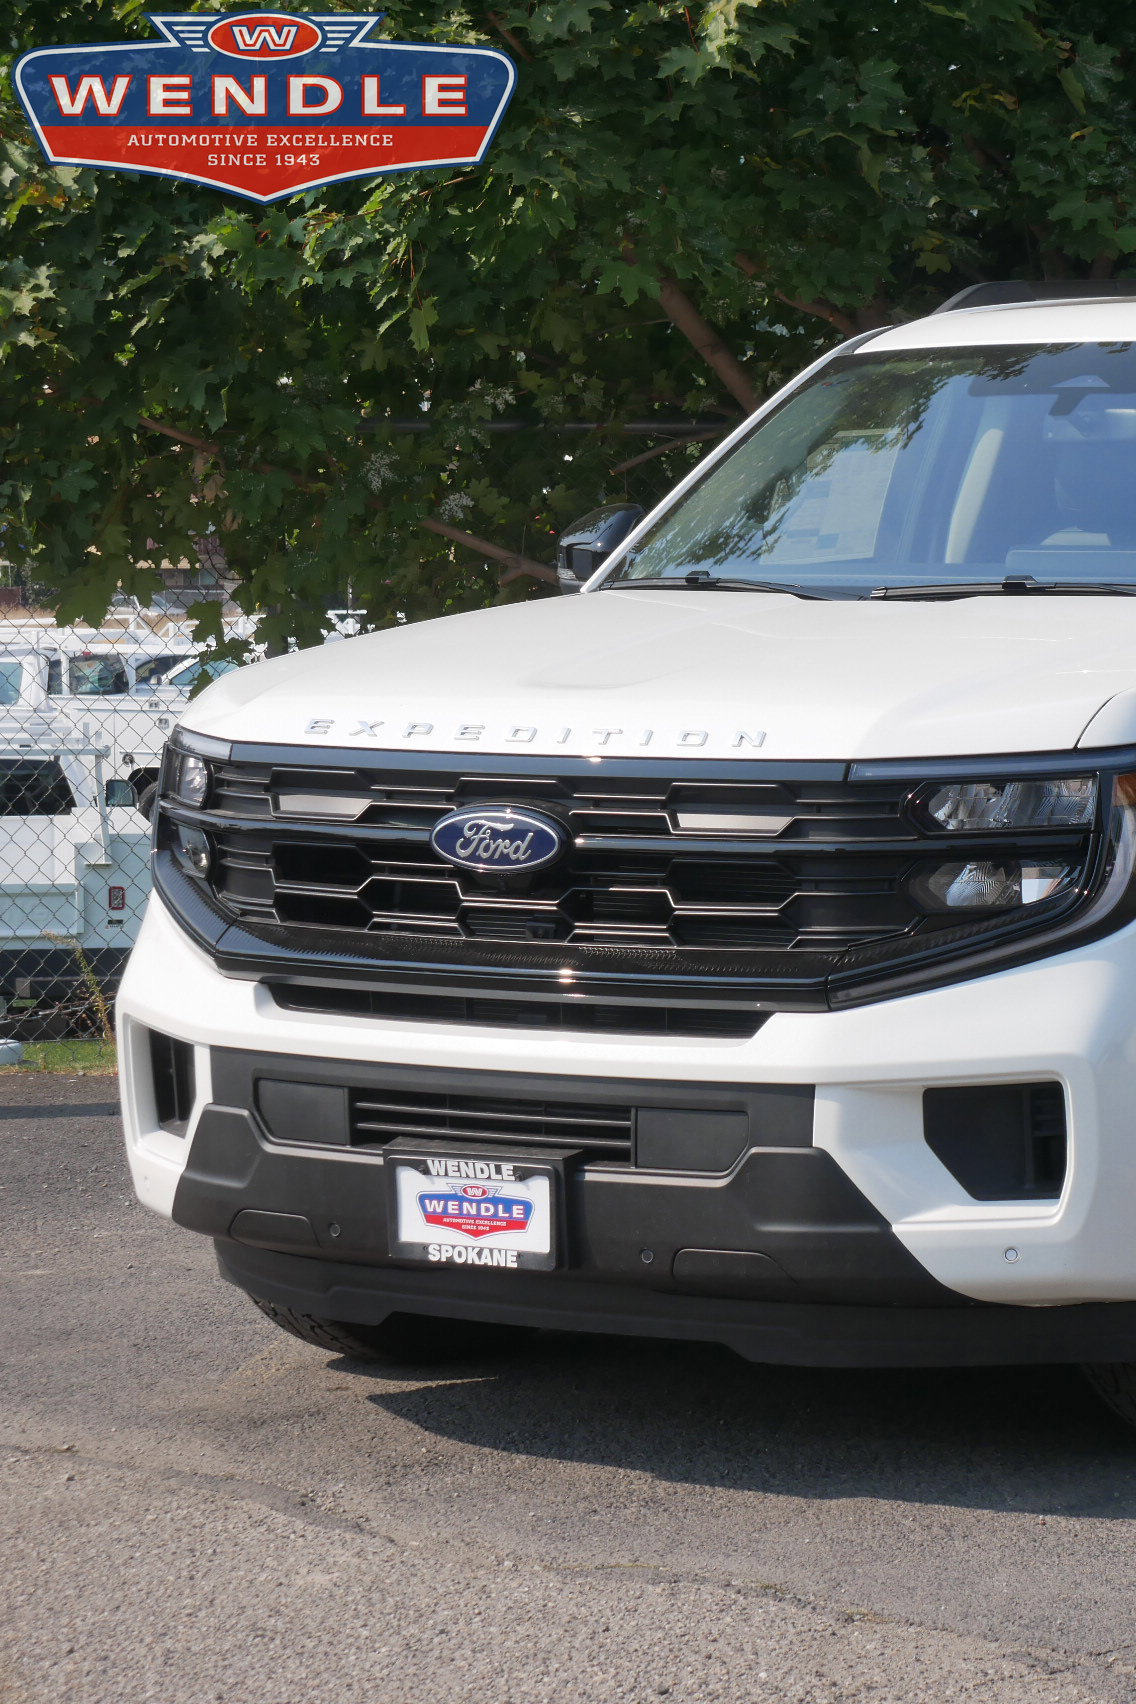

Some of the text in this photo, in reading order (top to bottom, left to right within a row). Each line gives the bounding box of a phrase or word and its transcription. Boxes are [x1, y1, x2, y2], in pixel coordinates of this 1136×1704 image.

[303, 718, 767, 748] EXPEDITION
[455, 819, 533, 862] Ford
[427, 1159, 516, 1181] WENDLE
[424, 1199, 525, 1218] WENDLE
[428, 1244, 518, 1267] SPOKANE
